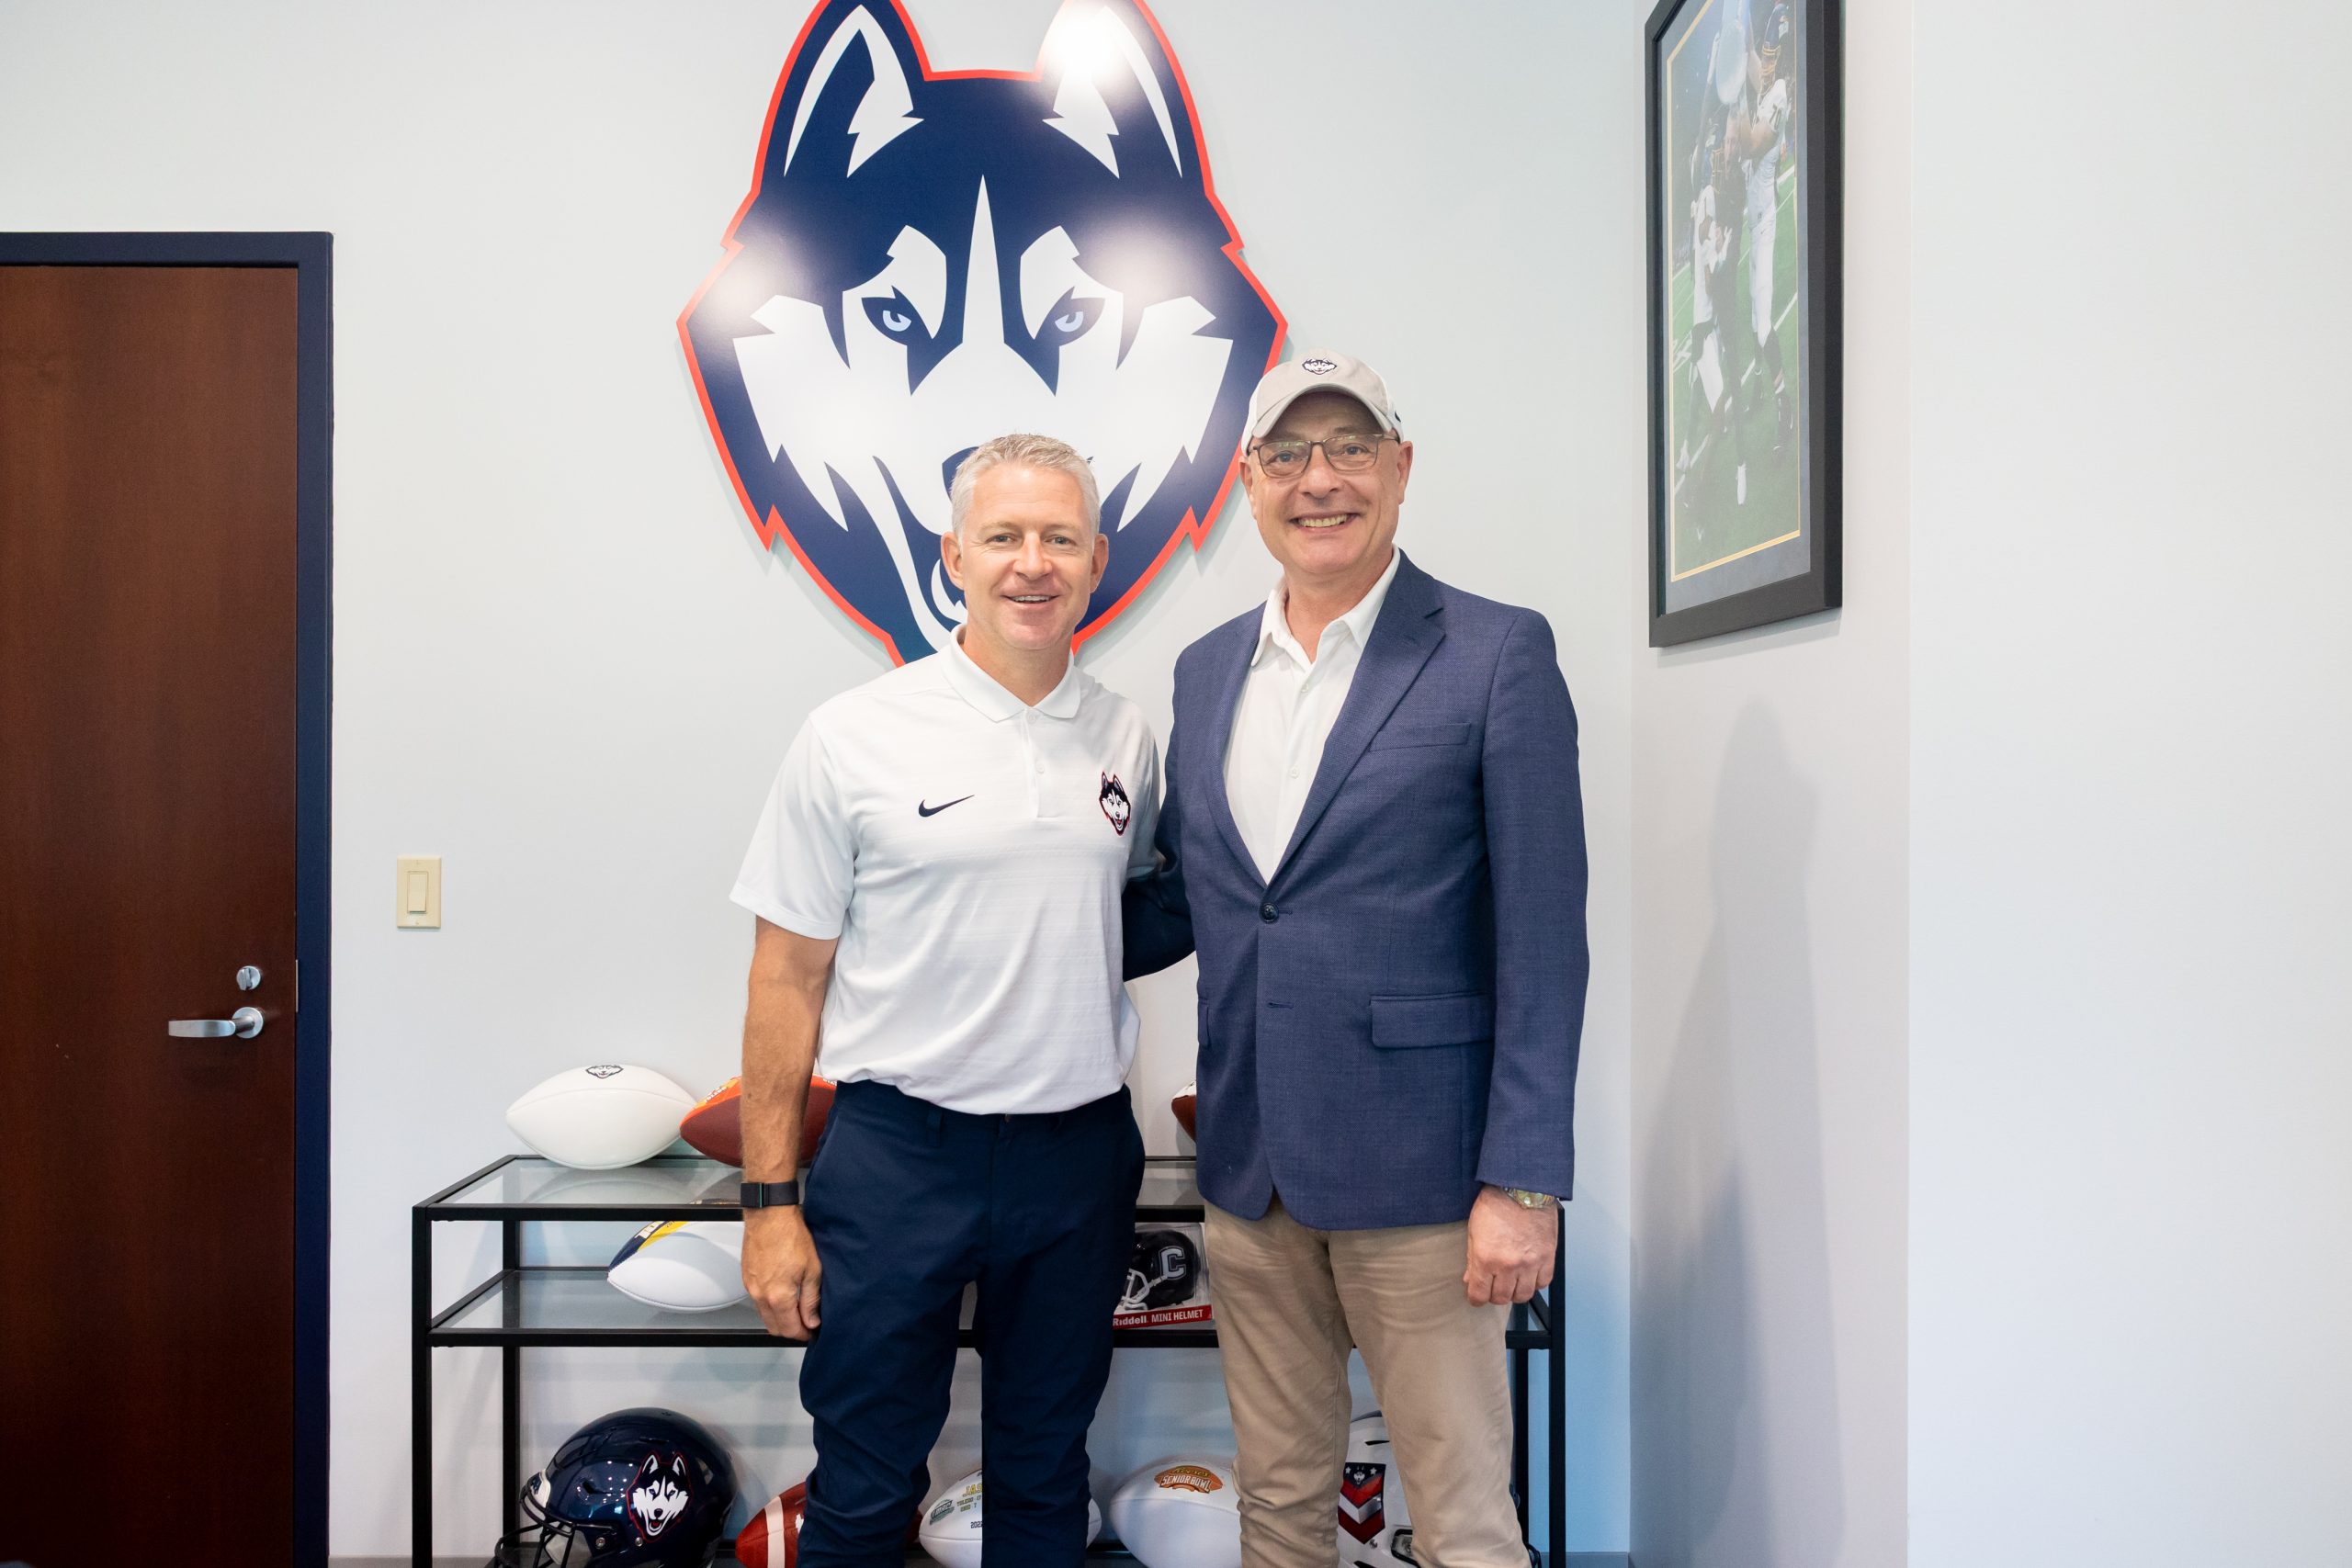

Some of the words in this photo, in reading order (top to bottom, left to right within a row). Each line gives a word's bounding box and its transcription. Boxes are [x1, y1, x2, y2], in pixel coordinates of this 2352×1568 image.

[1159, 1246, 1186, 1280] C
[1113, 1314, 1147, 1326] Riddell
[1151, 1313, 1171, 1323] MINI
[1173, 1309, 1204, 1321] HELMET
[1161, 1475, 1191, 1485] SENIOR
[1191, 1477, 1211, 1492] BOWL
